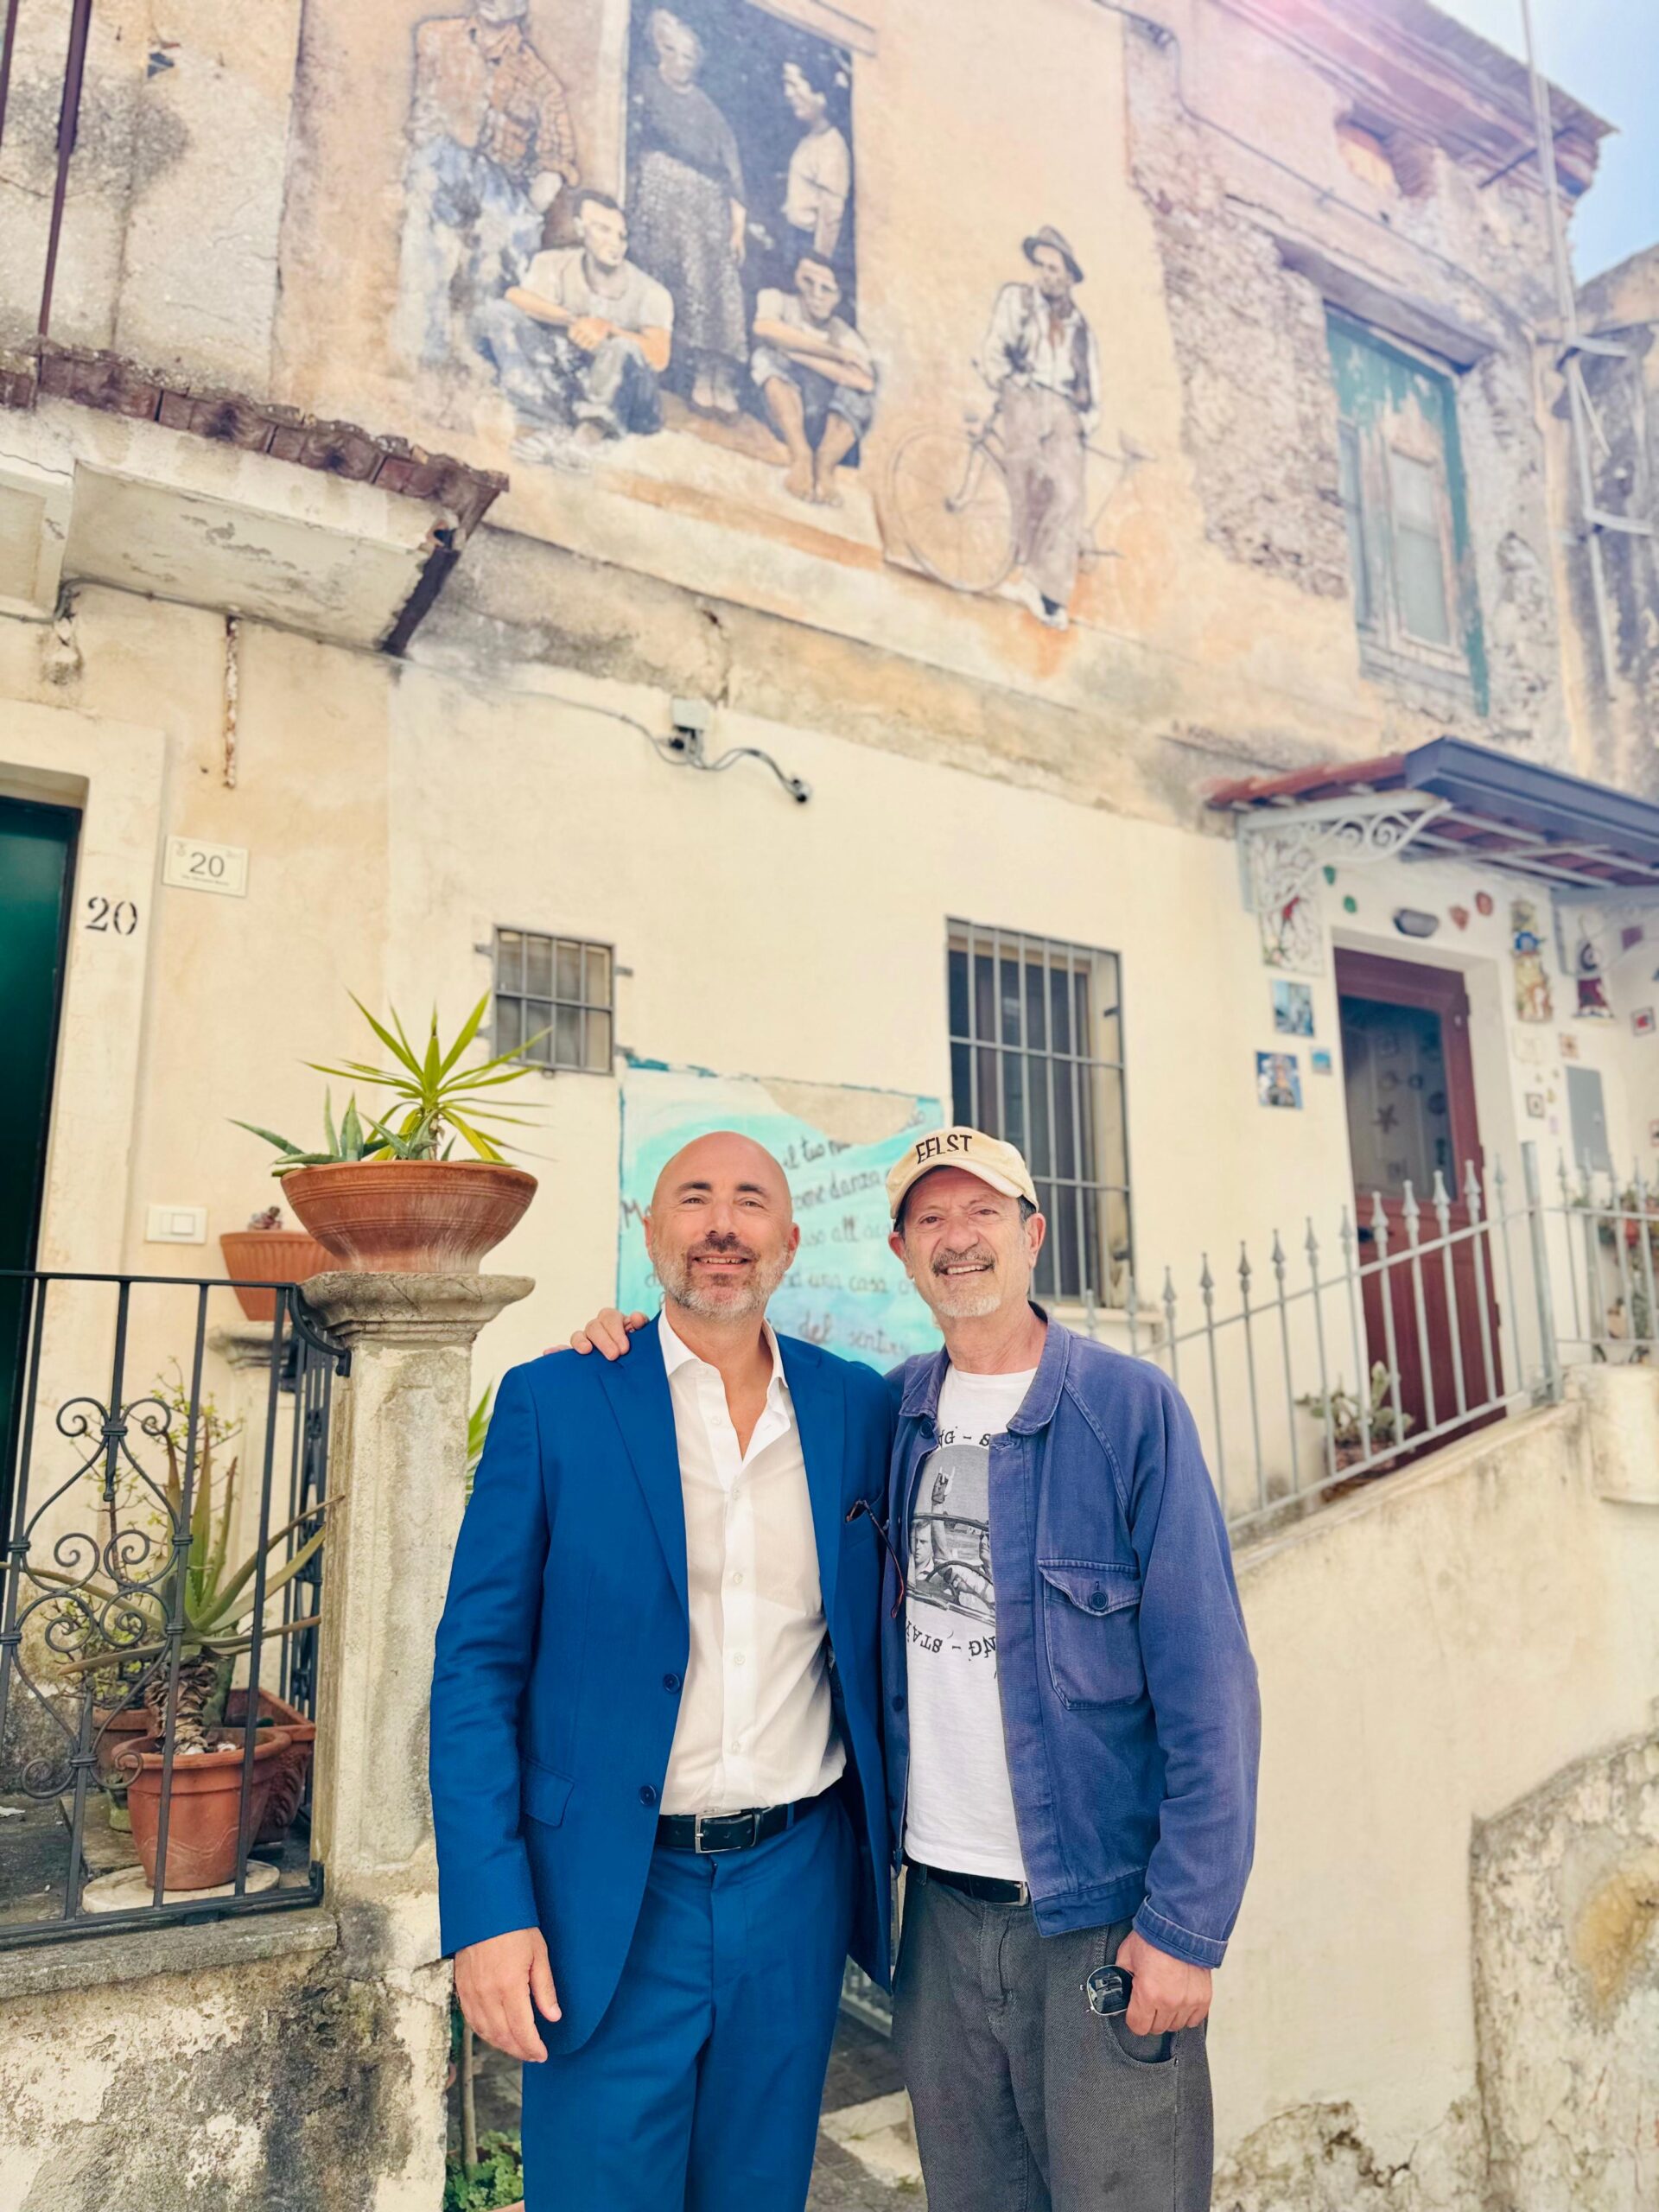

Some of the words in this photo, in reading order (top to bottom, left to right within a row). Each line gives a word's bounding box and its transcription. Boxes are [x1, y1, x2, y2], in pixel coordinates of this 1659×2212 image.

[189, 852, 225, 877] 20
[86, 897, 137, 935] 20
[830, 1170, 881, 1199] danza
